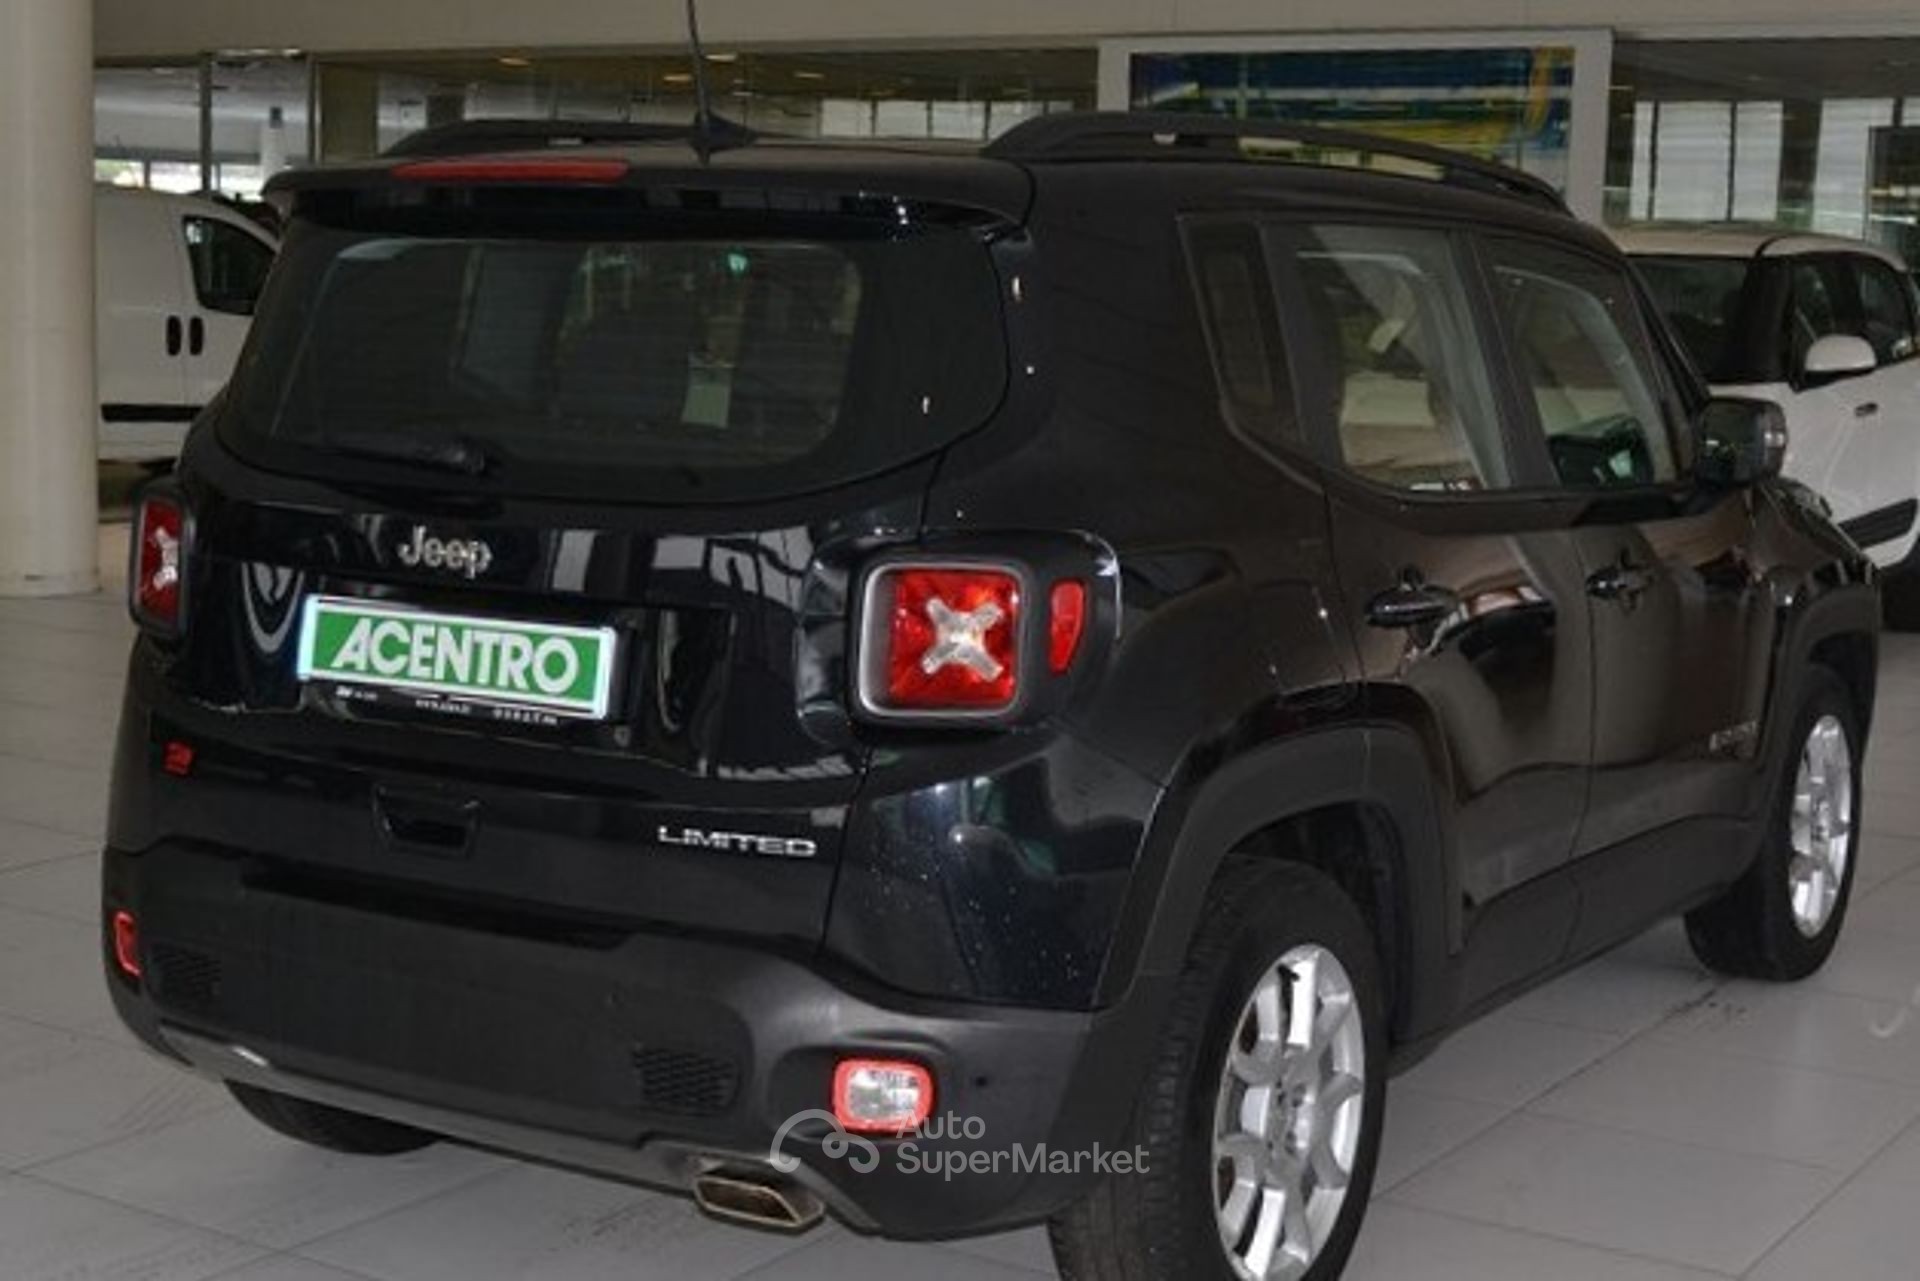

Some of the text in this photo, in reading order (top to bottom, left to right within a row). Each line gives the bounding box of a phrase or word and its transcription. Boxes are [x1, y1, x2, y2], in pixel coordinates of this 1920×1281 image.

[398, 525, 492, 579] Jeep
[331, 617, 579, 695] ACENTRO
[657, 825, 816, 858] LIMITED
